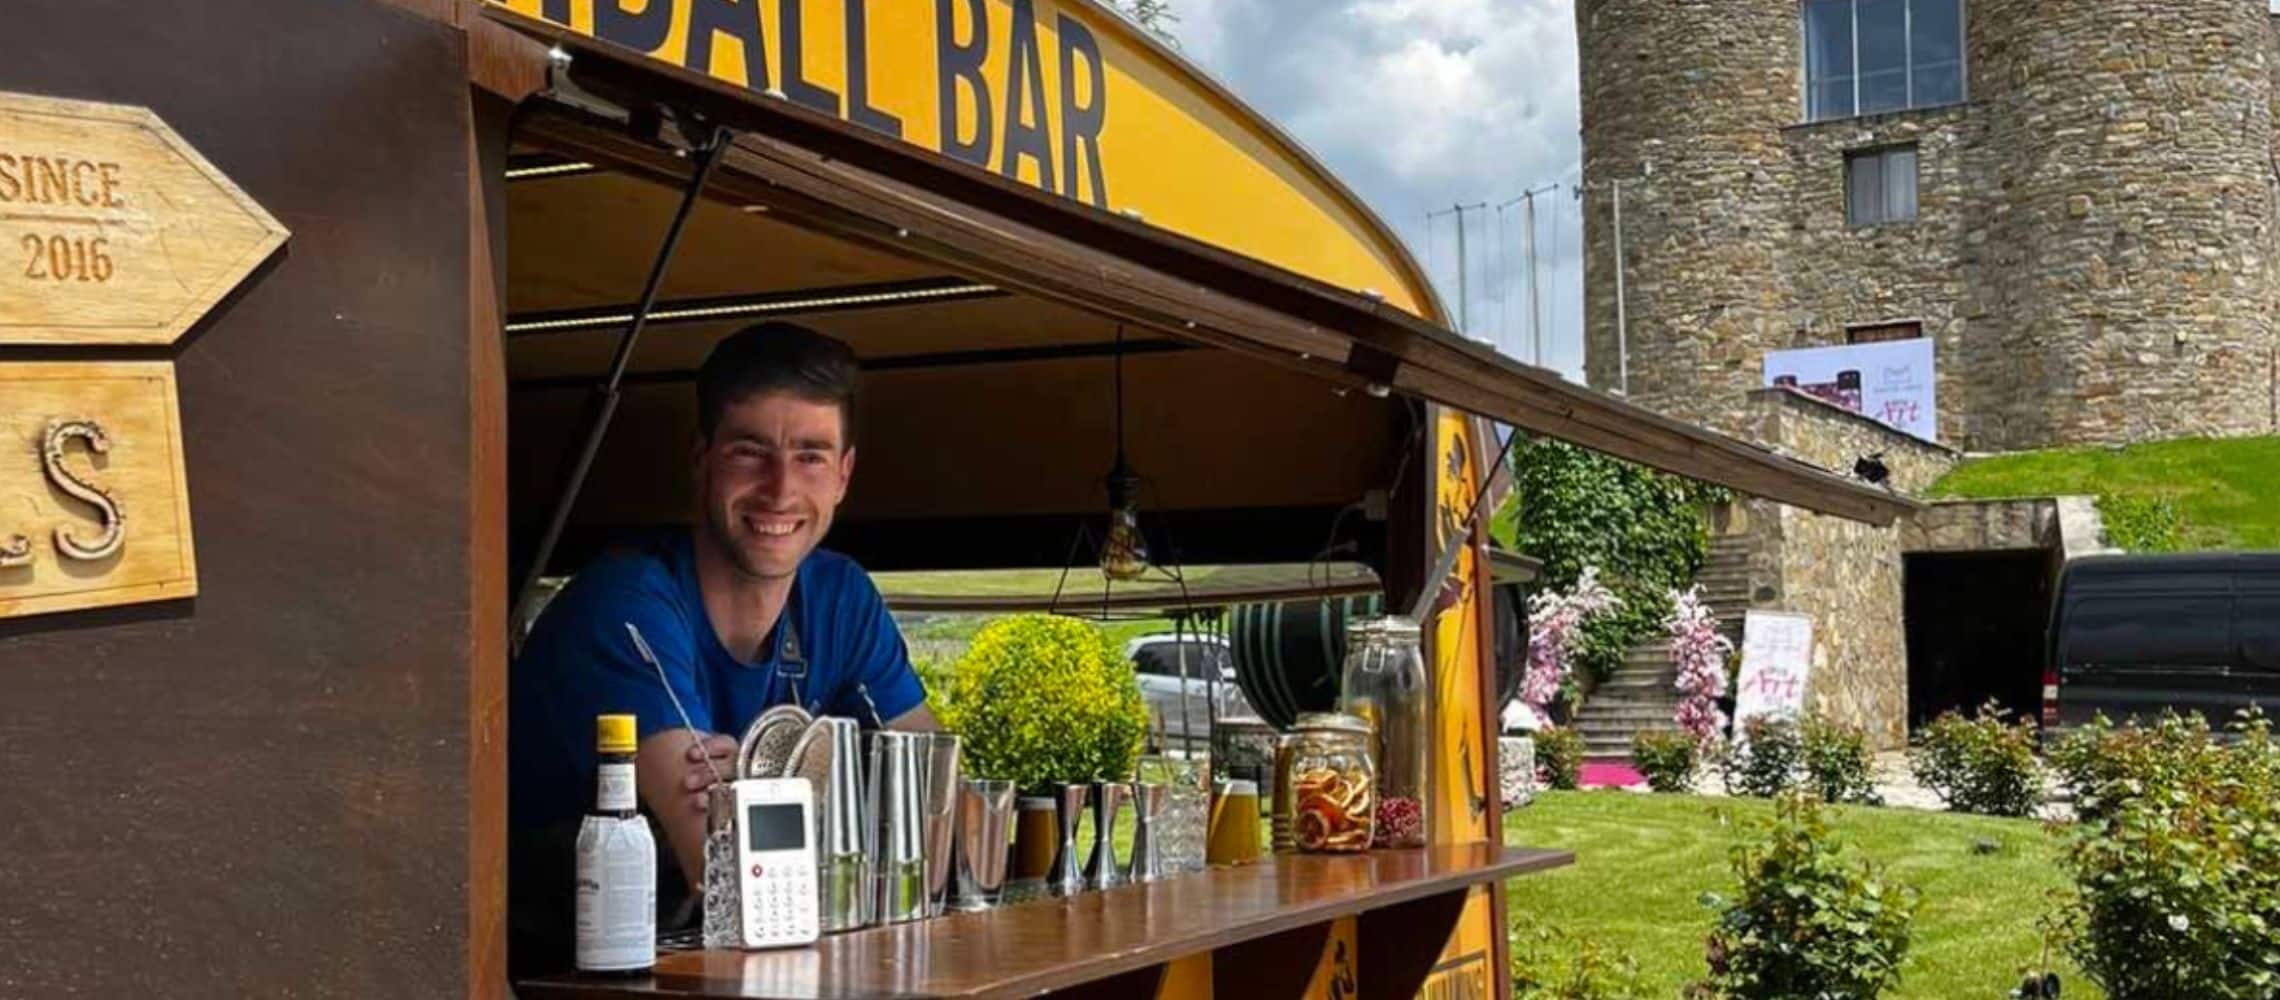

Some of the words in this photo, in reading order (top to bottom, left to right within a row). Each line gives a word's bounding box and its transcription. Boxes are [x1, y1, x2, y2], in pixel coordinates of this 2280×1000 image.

[936, 0, 1109, 210] BAR
[0, 153, 124, 208] SINCE
[21, 233, 113, 282] 2016
[0, 421, 127, 566] S
